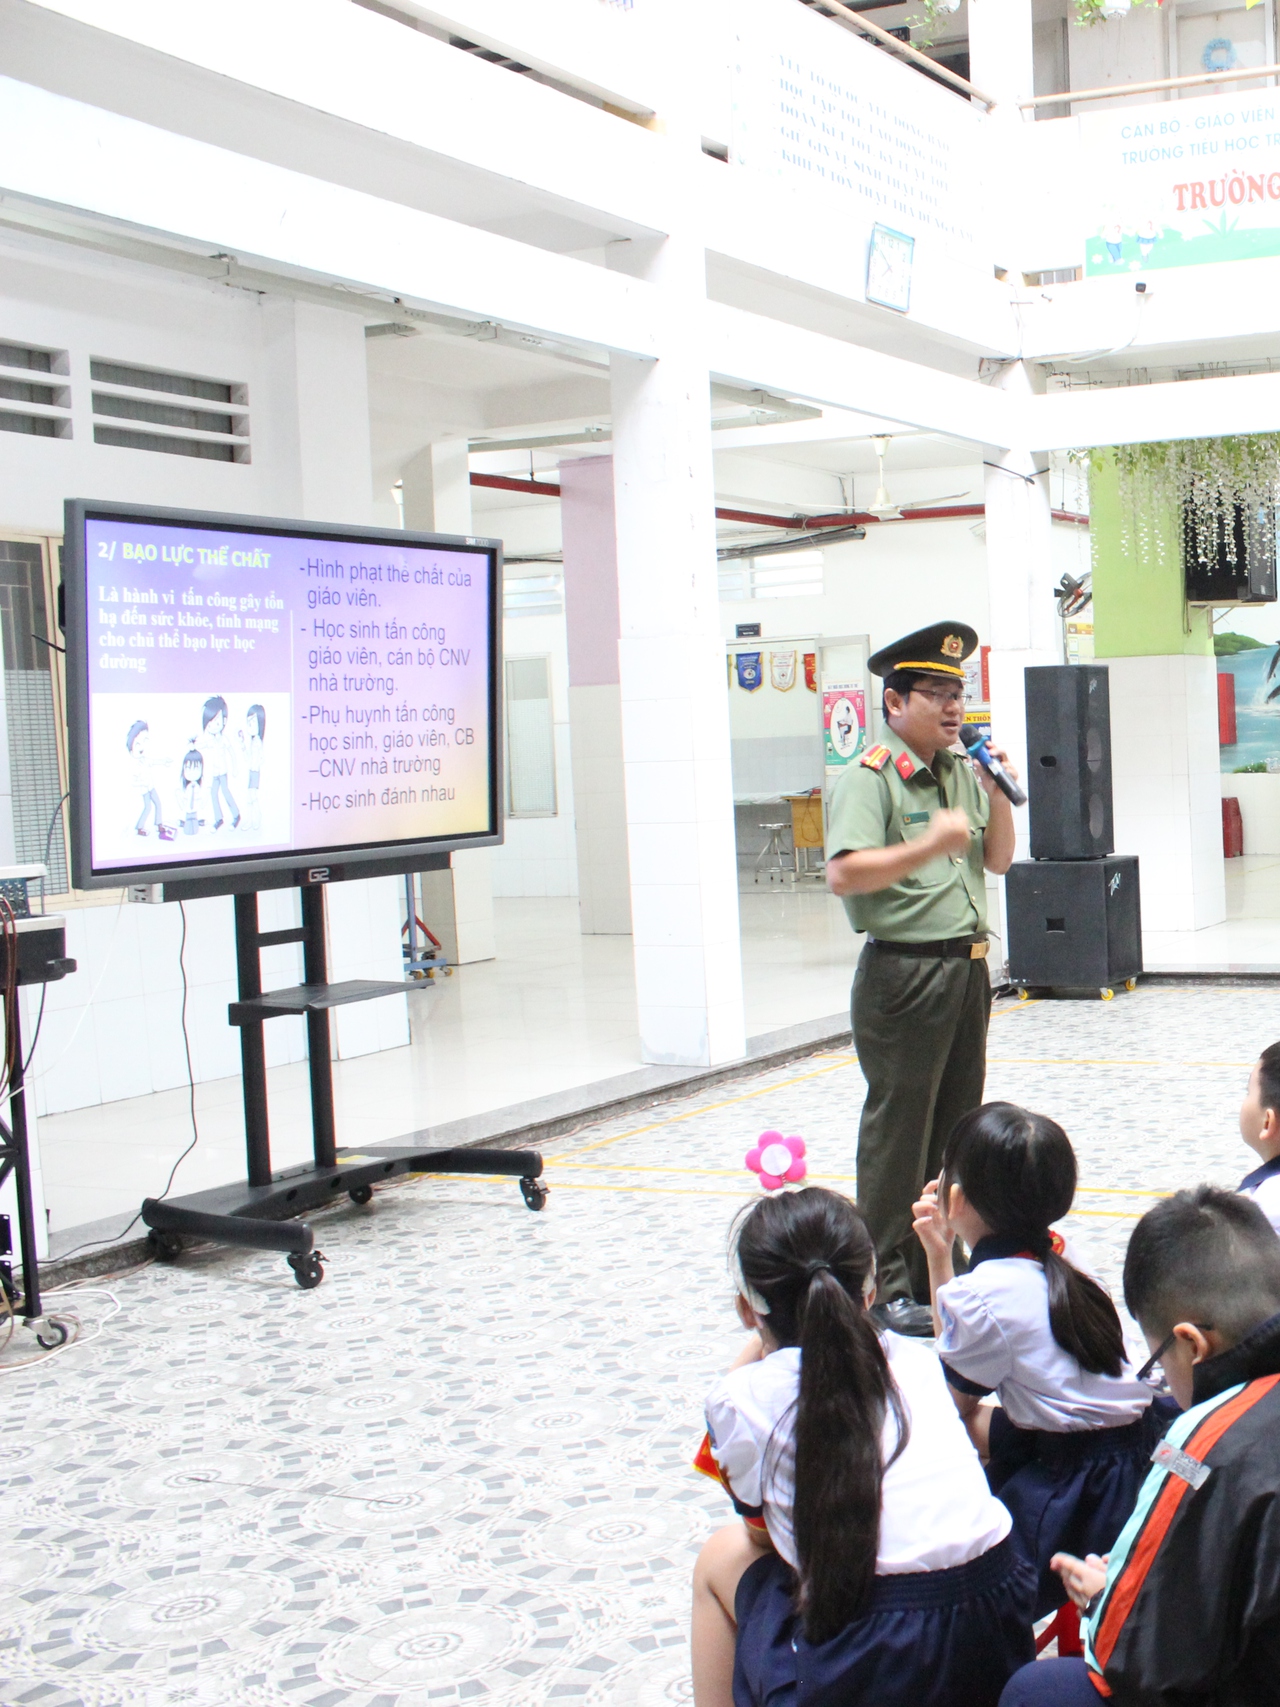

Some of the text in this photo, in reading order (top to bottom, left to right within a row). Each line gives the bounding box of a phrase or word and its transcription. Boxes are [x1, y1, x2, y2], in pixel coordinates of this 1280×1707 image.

[98, 541, 271, 568] 2/ BẠO LỰC THỂ CHẤT
[350, 562, 382, 584] phạt
[387, 561, 409, 583] thể
[415, 563, 444, 585] chất
[448, 568, 472, 587] của
[98, 586, 284, 612] Là hành vi tấn công gây tổn
[308, 586, 381, 609] giáo viên.
[99, 608, 116, 627] hạ
[121, 606, 147, 625] đến
[151, 611, 173, 626] sức
[217, 613, 241, 628] tính
[245, 618, 279, 633] mạng
[314, 617, 445, 645] Học sinh tấn công
[99, 629, 255, 653] cho chủ thể bạo lực học
[100, 654, 147, 673] đường
[309, 646, 470, 669] giáo viên, cán bộ CNV
[309, 674, 398, 695] nhà trường.
[346, 705, 390, 727] huynh
[396, 700, 417, 722] tấn
[422, 704, 455, 725] công
[309, 728, 474, 754] học sinh, giáo viên, CB
[361, 757, 387, 775] nhà
[393, 755, 440, 775] trường
[345, 789, 376, 808] sinh
[381, 786, 416, 805] đánh
[422, 785, 455, 802] nhau
